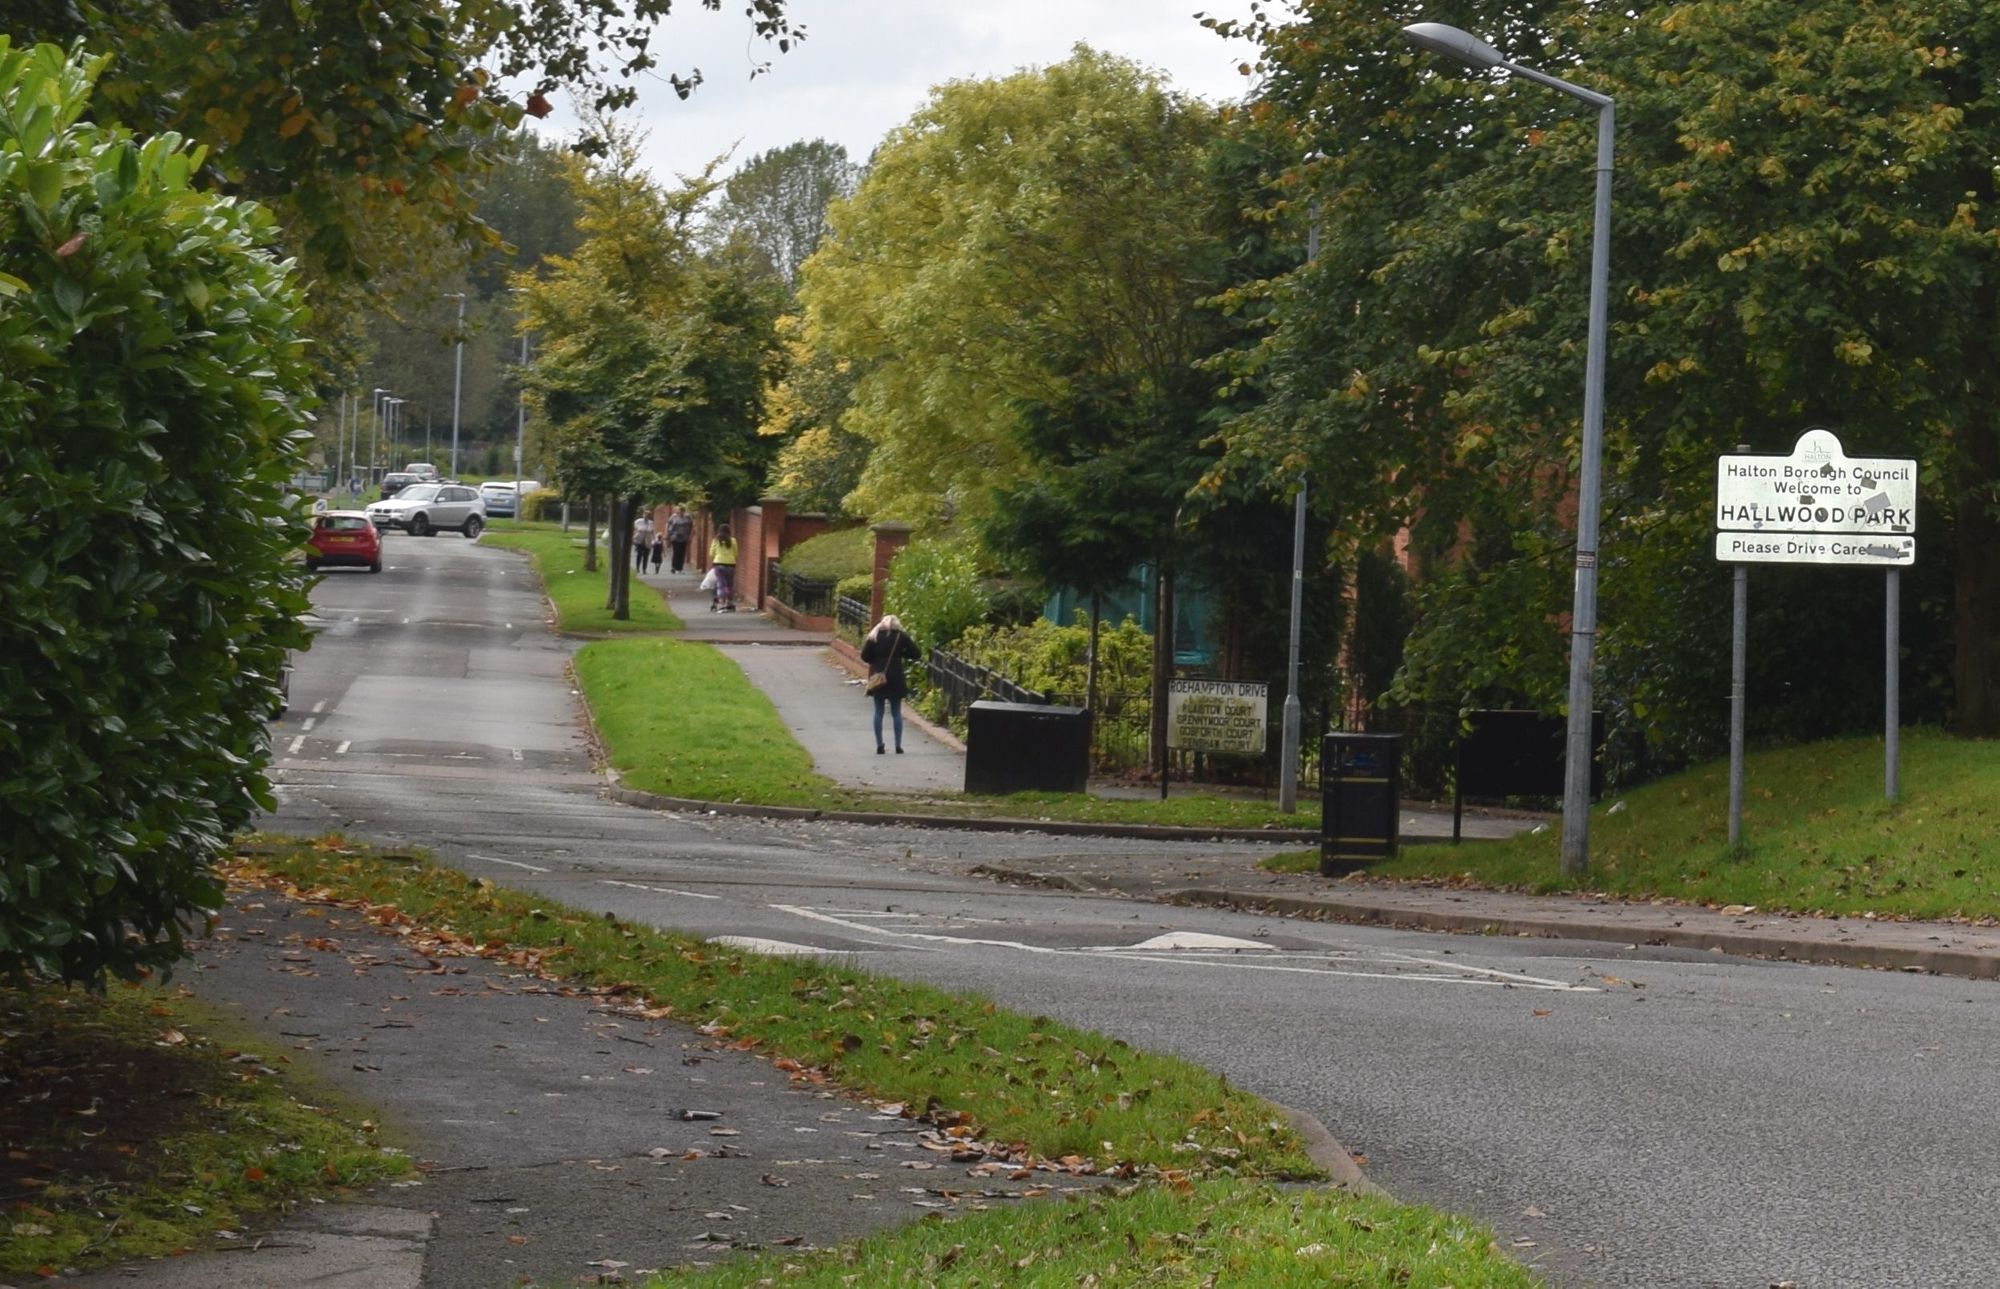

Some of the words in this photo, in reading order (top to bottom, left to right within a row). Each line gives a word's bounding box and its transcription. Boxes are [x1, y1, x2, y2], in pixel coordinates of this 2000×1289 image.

[1727, 464, 1777, 477] Halton
[1784, 465, 1846, 481] Borough
[1852, 467, 1909, 481] Council
[1774, 482, 1841, 495] Welcome
[1847, 483, 1862, 495] to
[1721, 505, 1845, 523] HALLWOOD
[1854, 508, 1911, 525] PARK
[1732, 540, 1780, 554] Please
[1787, 541, 1825, 555] Drive
[1831, 542, 1900, 559] Carefy
[1169, 681, 1234, 695] ROEHAMPTON
[1239, 684, 1267, 697] DRIVE
[1225, 706, 1252, 717] COURT
[1234, 717, 1261, 728] COURT
[1226, 728, 1254, 739] COURT
